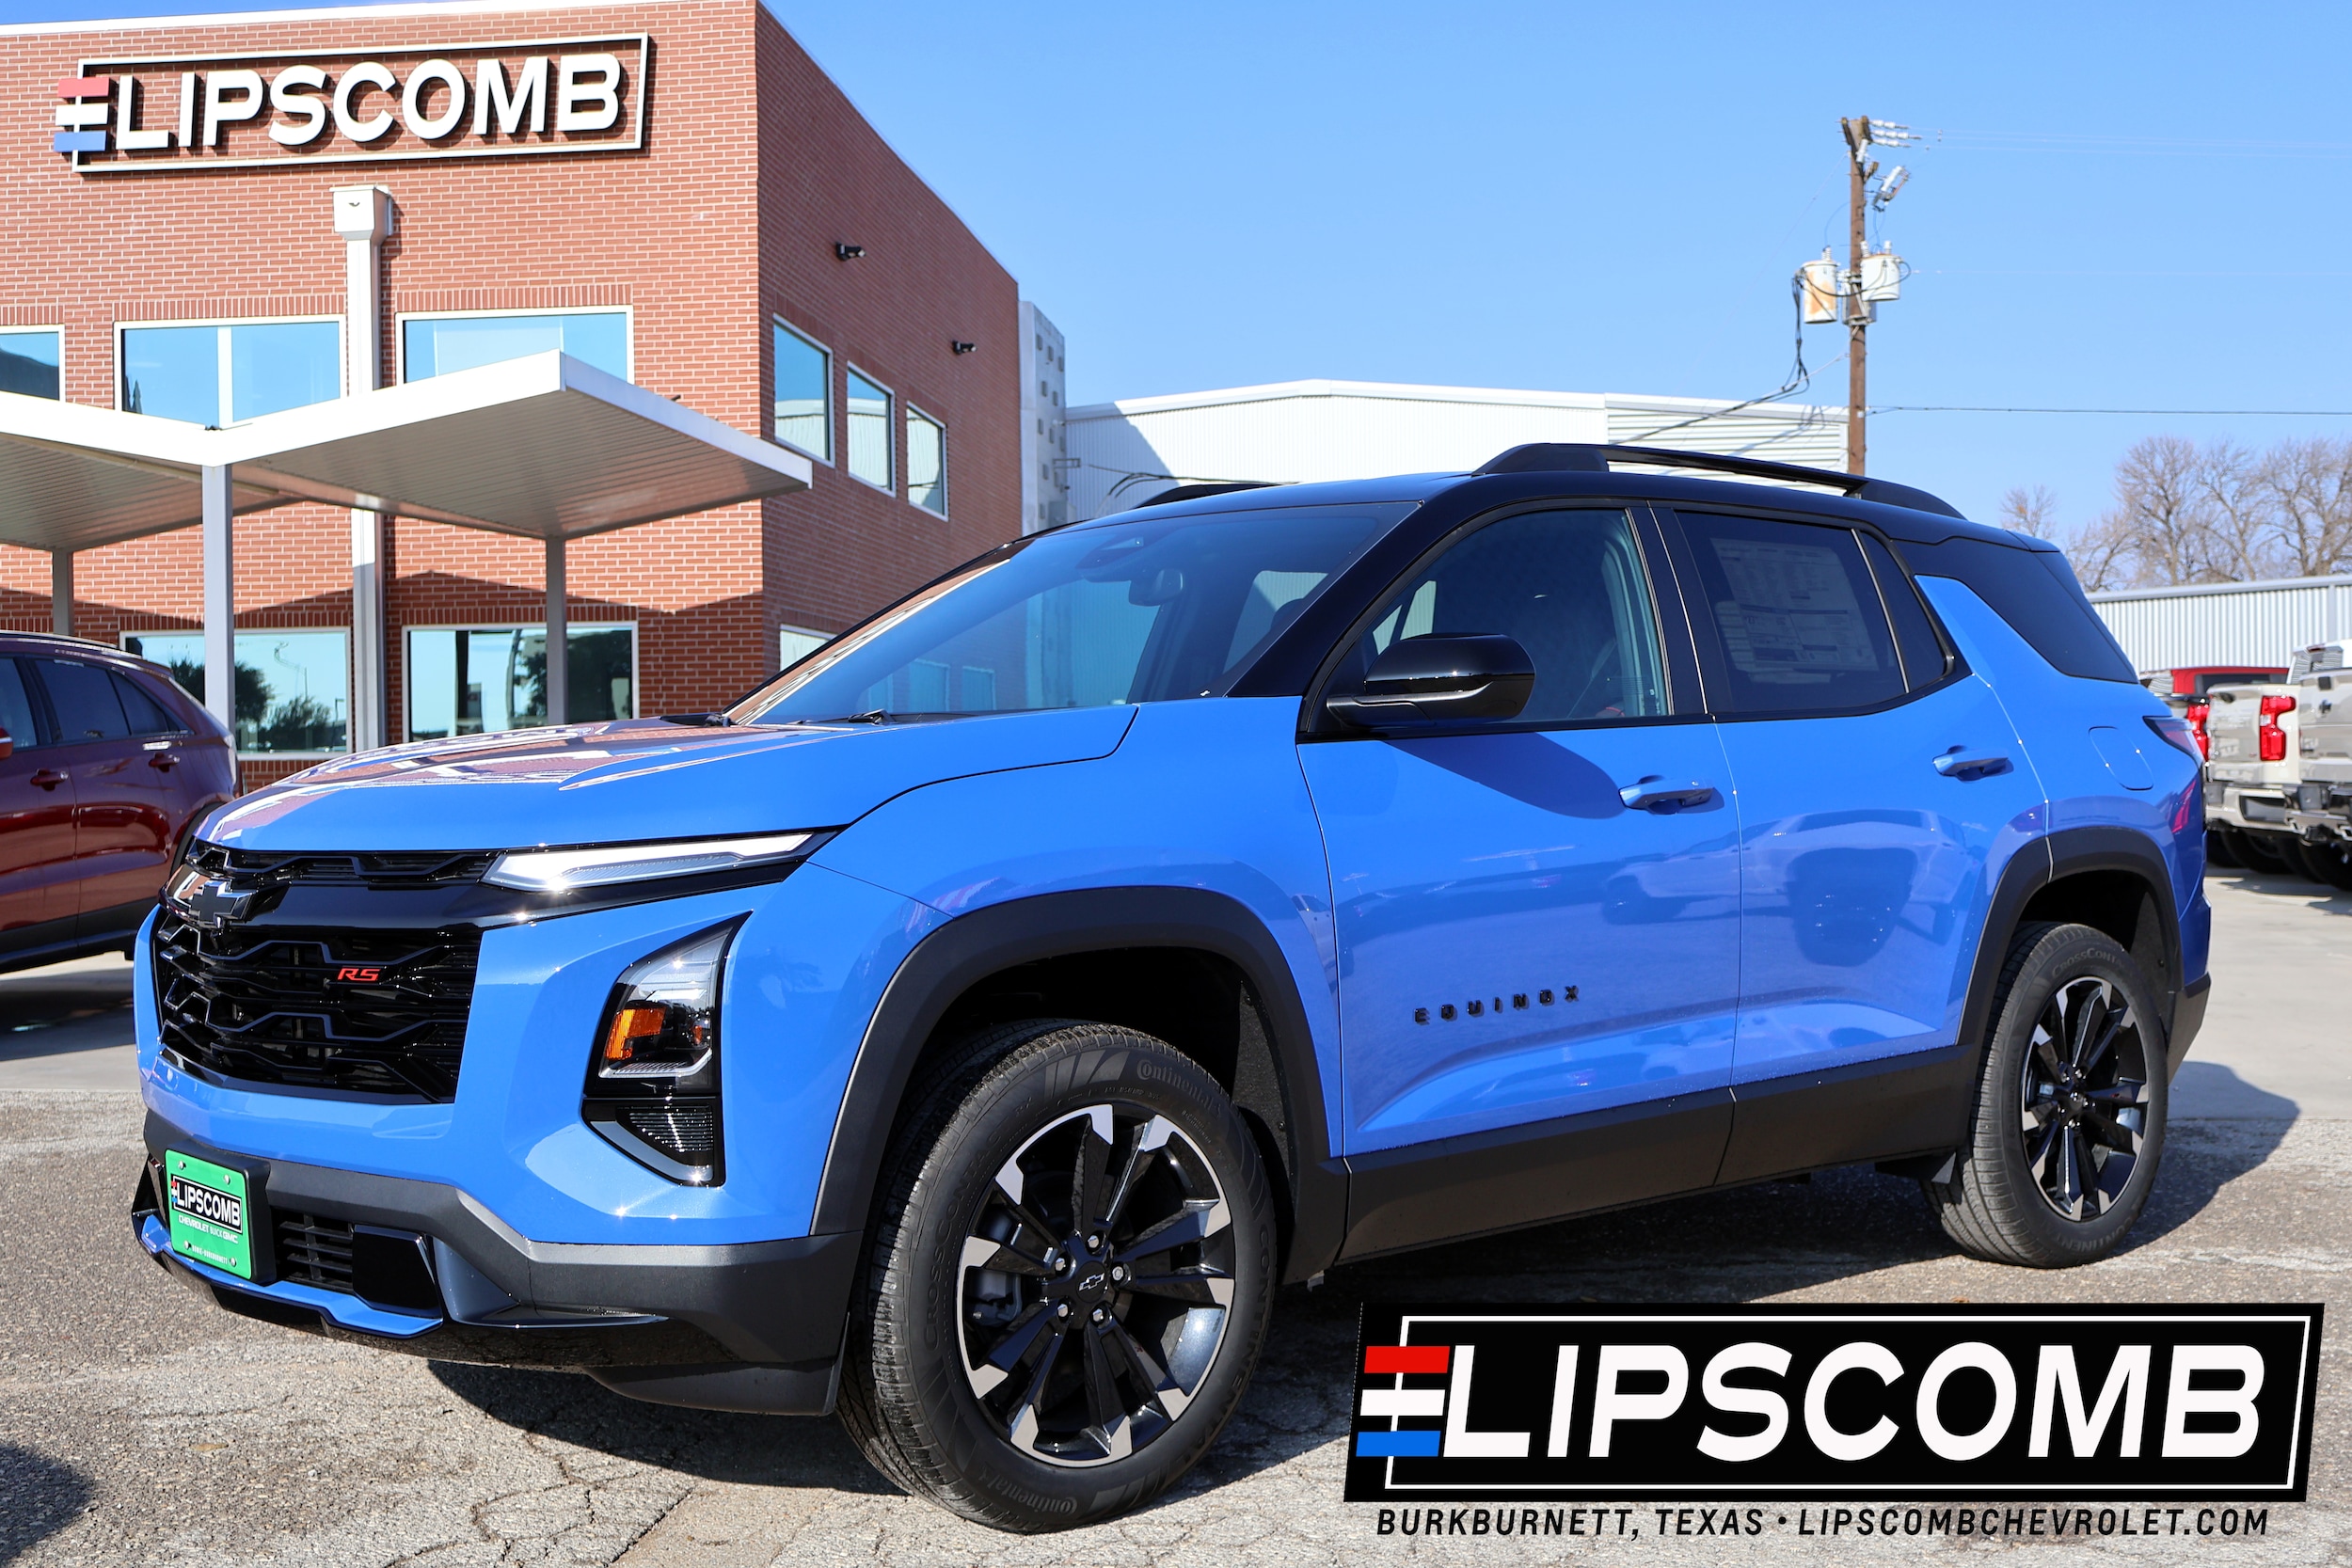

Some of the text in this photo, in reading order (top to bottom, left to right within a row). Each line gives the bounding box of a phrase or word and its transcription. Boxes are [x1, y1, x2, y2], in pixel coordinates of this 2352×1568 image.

[116, 53, 621, 150] LIPSCOMB
[338, 967, 381, 982] RS
[1414, 985, 1579, 1024] EQUINOX
[1136, 1059, 1216, 1110] Continental
[176, 1181, 241, 1227] LIPSCOMB
[178, 1214, 210, 1234] CHEVROLET
